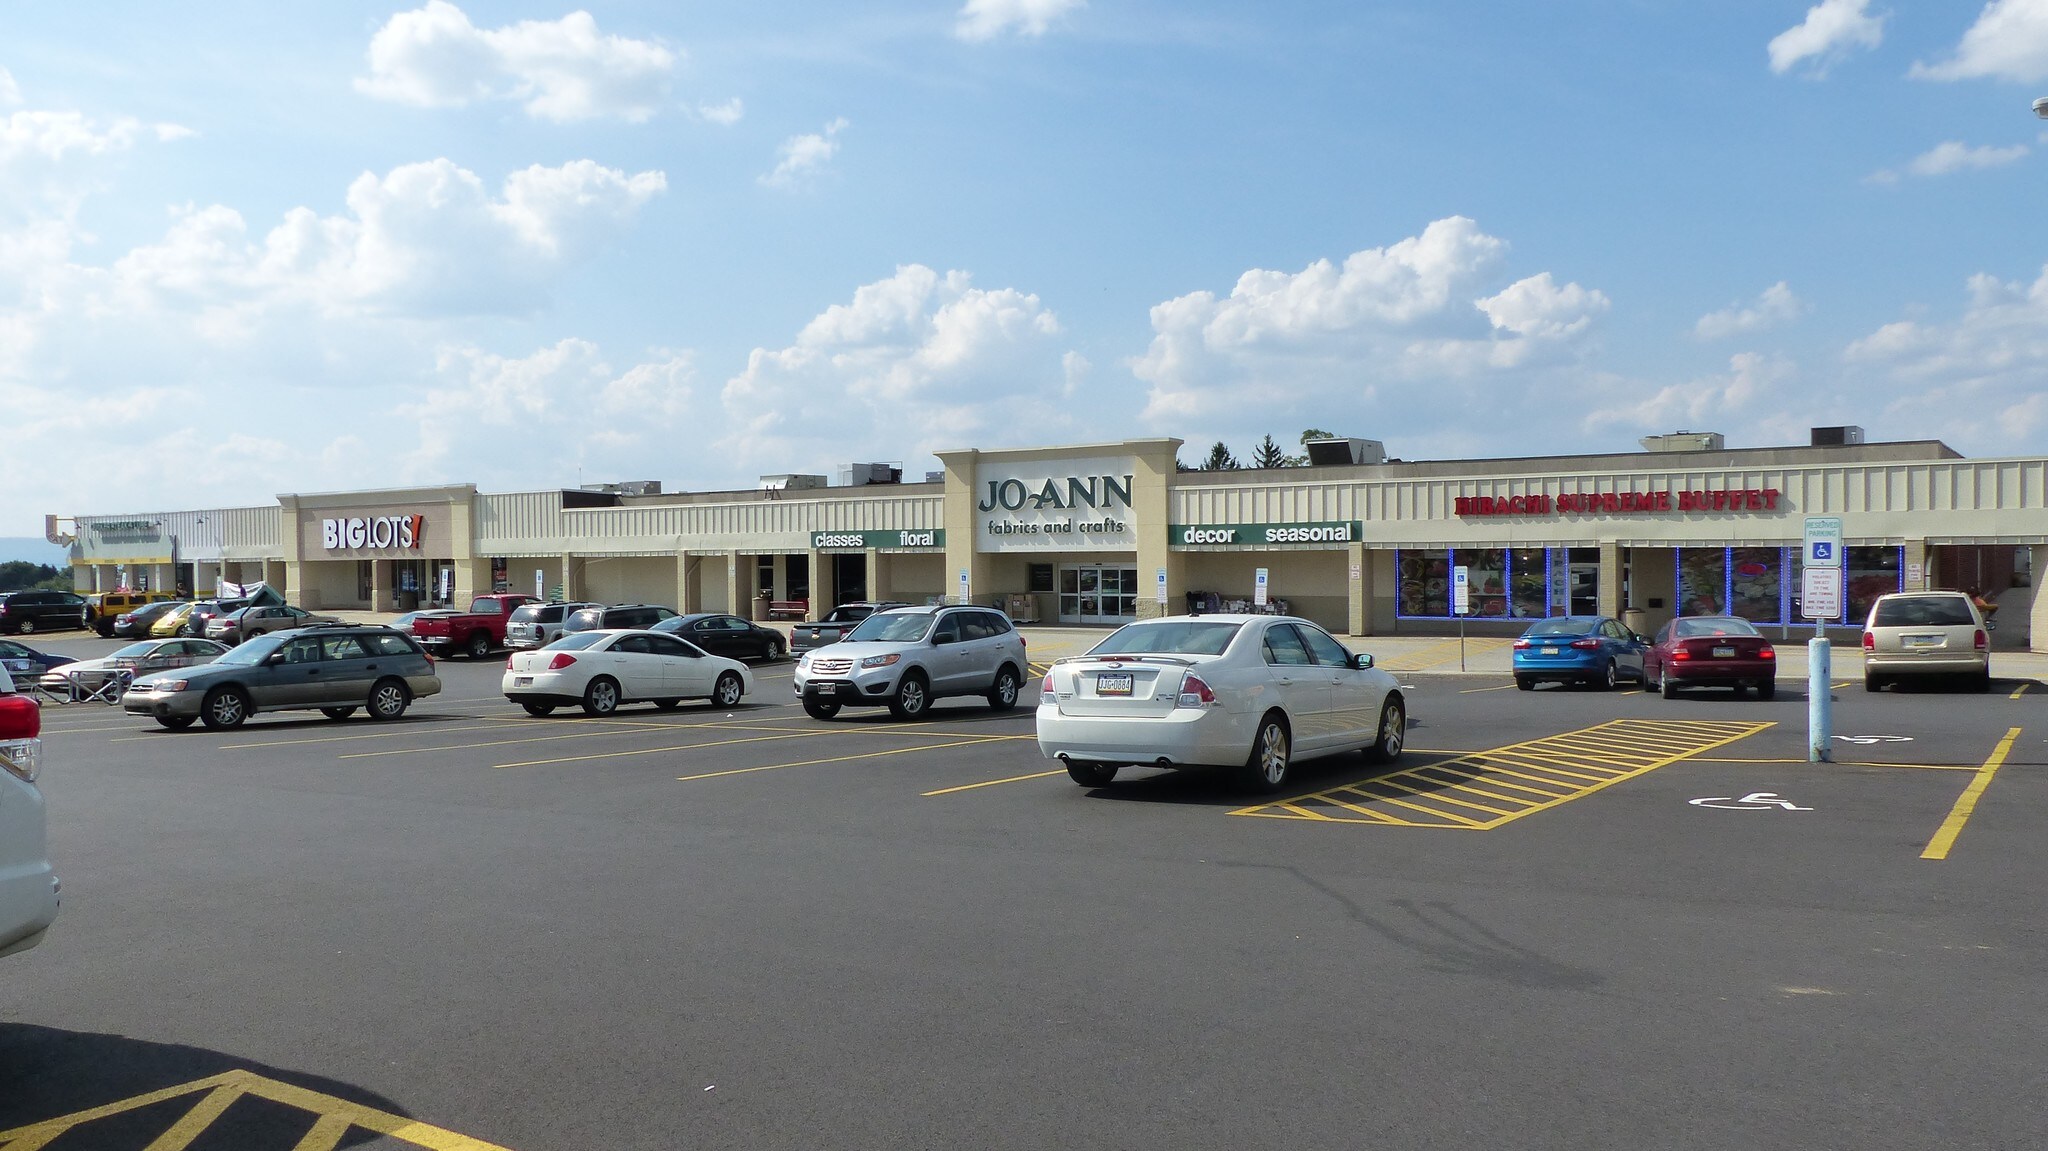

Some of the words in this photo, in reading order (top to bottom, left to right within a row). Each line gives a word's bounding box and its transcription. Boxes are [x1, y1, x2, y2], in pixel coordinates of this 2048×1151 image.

[1454, 494, 1551, 515] HIBACHI
[1556, 491, 1672, 513] SUPREME
[1677, 489, 1779, 511] BUFFET
[988, 520, 1038, 535] fabrics
[1043, 518, 1072, 533] and
[1078, 517, 1125, 533] crafts
[1183, 526, 1236, 543] decor
[1265, 523, 1352, 542] seasonal
[1806, 521, 1840, 529] RESERVED
[815, 532, 863, 547] classes
[899, 530, 935, 546] floral
